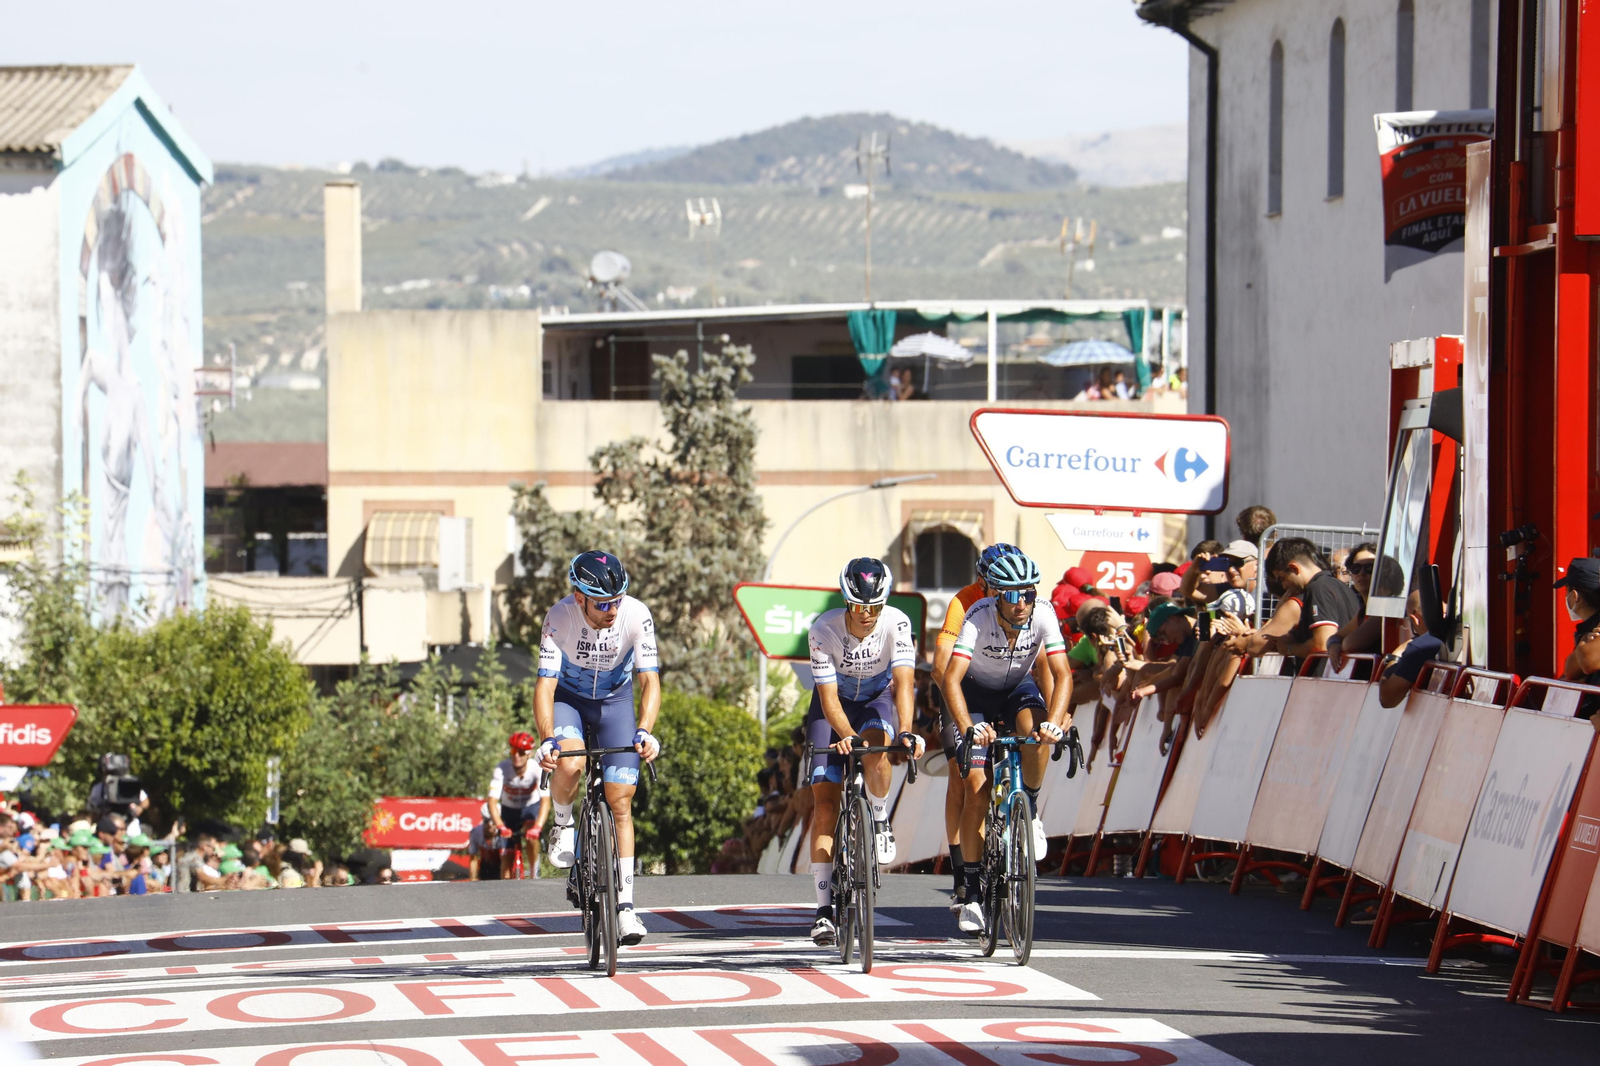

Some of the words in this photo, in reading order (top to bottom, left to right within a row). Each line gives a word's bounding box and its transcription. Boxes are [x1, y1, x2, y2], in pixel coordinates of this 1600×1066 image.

[1429, 171, 1453, 184] CON
[1399, 196, 1417, 217] LA
[1402, 220, 1433, 239] FINAL
[1006, 445, 1141, 473] Carrefour
[1072, 527, 1125, 538] Carrefour
[1095, 561, 1135, 590] 25
[576, 640, 609, 652] ISRAEL
[1473, 769, 1540, 850] Carrefour
[399, 811, 474, 832] Cofidis
[29, 963, 1027, 1034] COFIDIS
[79, 1020, 1179, 1066] FIDIS
